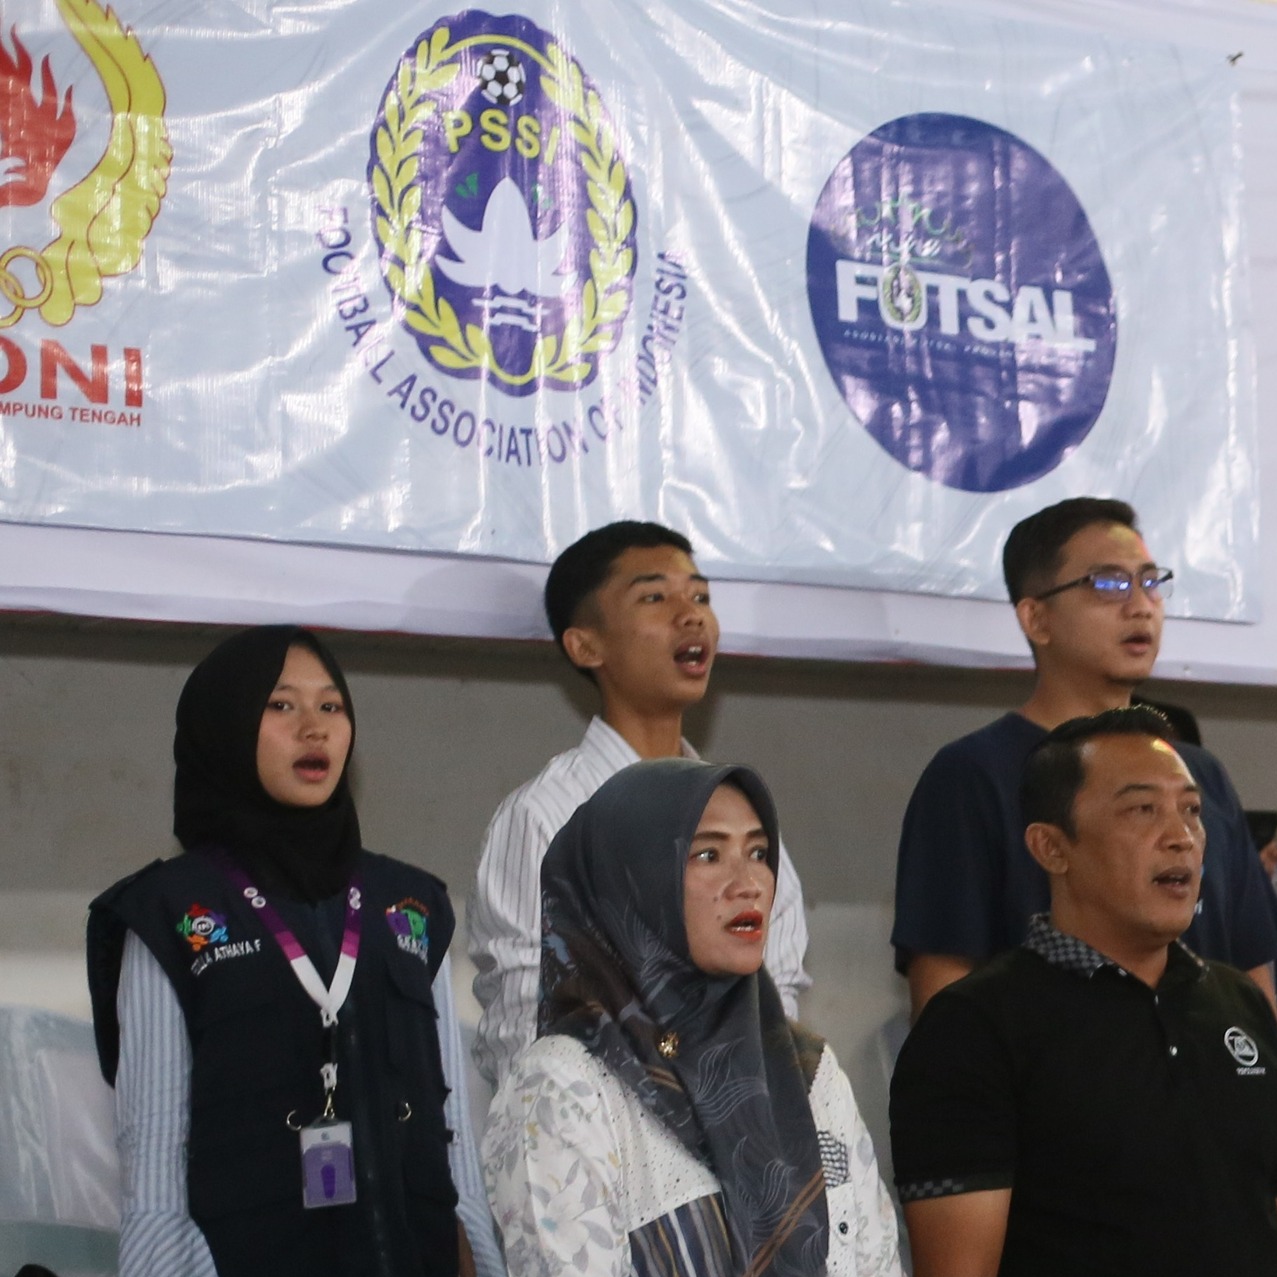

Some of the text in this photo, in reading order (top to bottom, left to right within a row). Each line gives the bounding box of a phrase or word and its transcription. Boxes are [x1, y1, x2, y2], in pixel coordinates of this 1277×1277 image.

[442, 107, 561, 167] PSSI
[835, 259, 1097, 353] FUTSAL
[69, 406, 142, 427] TENGAH
[386, 373, 590, 468] ASSOCIATION
